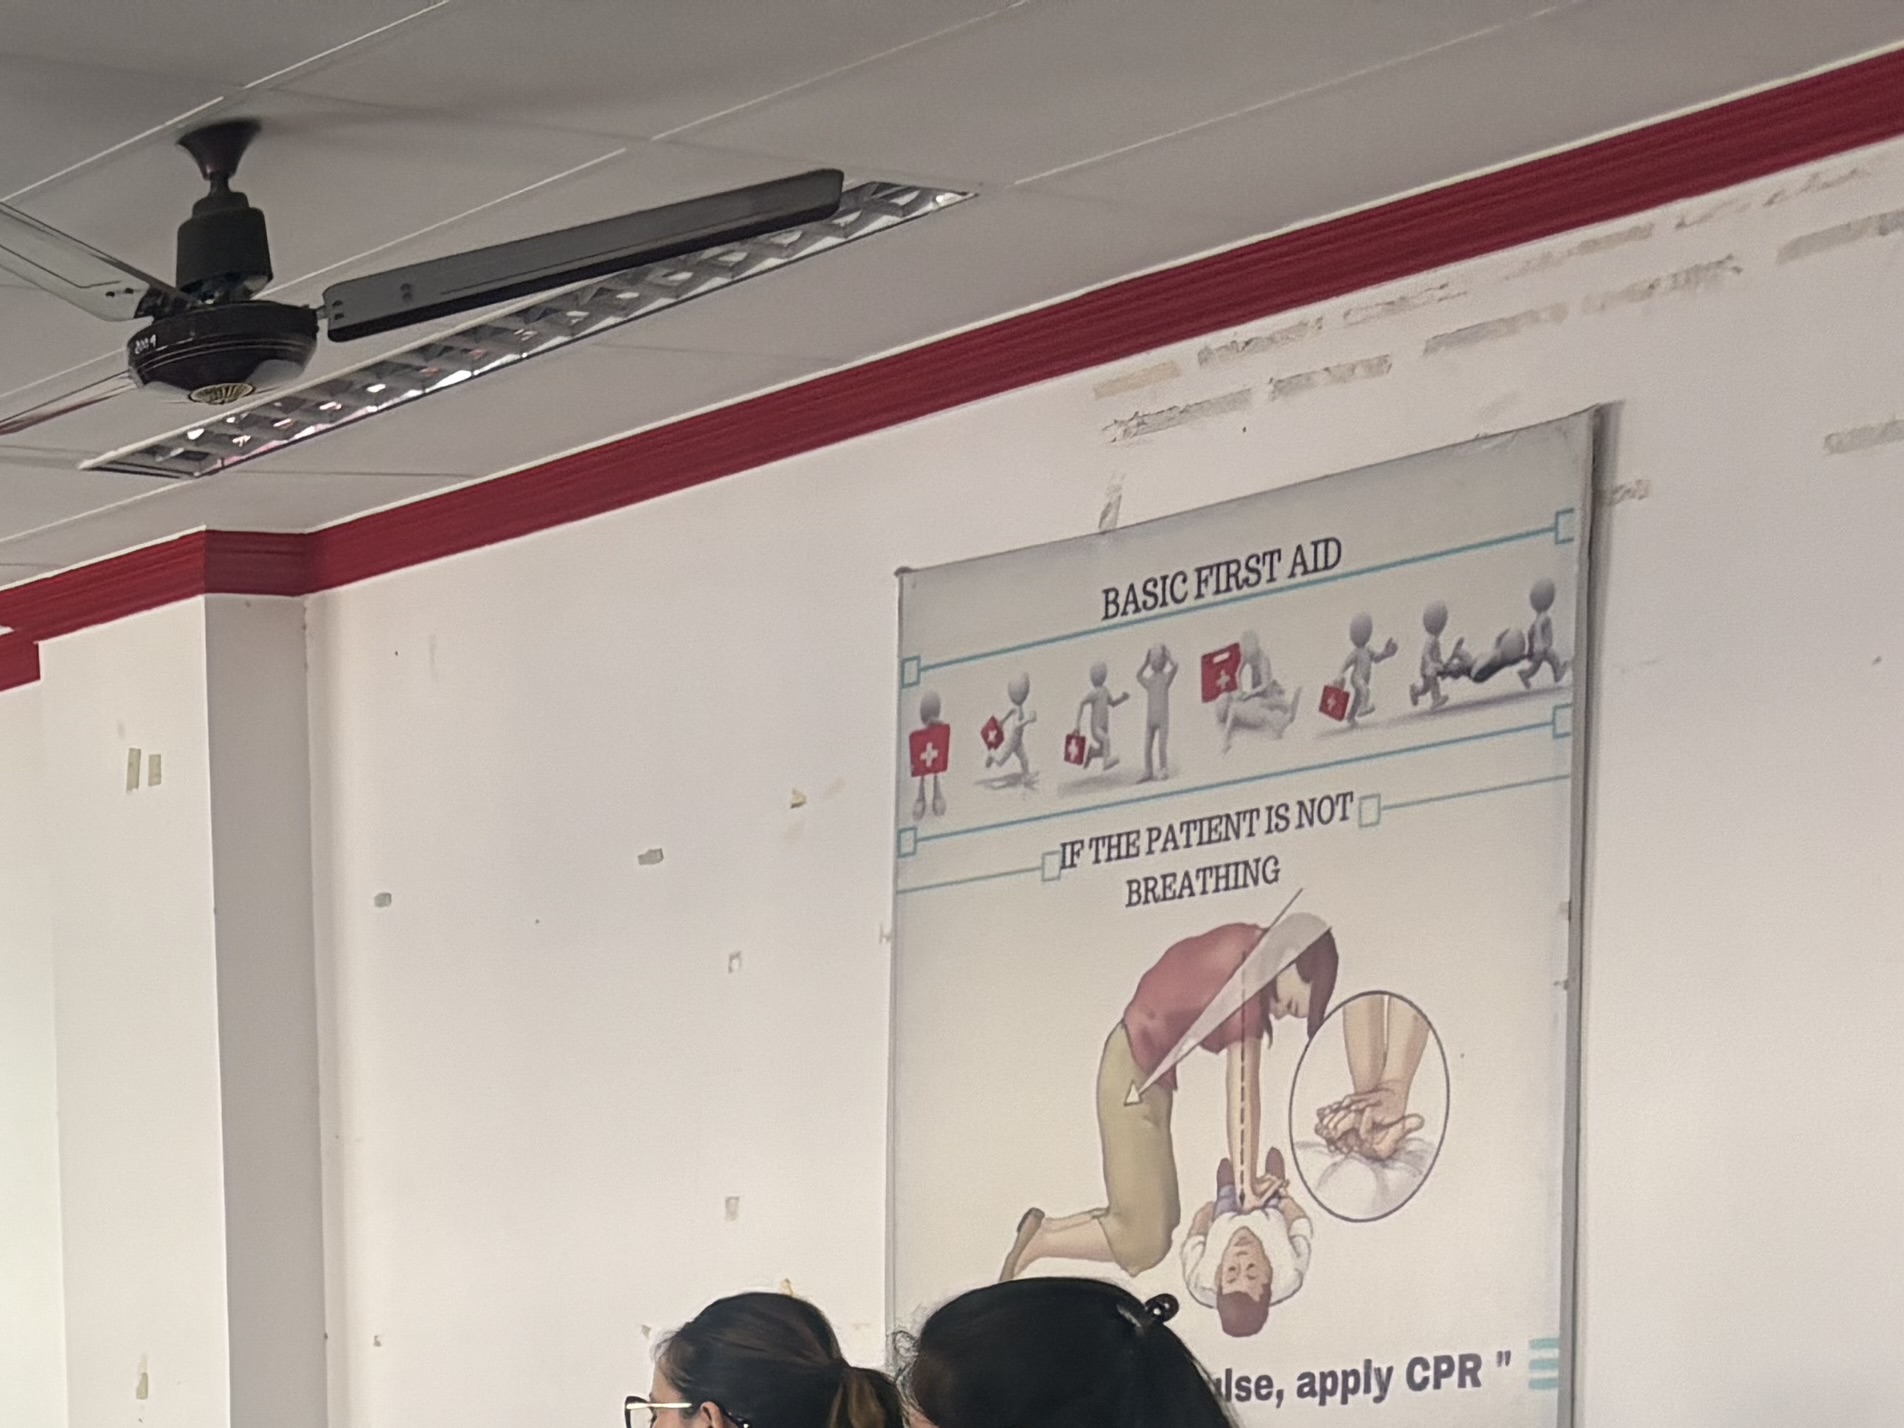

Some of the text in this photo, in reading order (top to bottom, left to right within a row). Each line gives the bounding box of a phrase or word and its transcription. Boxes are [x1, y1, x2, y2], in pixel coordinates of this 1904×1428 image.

[1101, 537, 1342, 621] BASIC FIRST AID
[1059, 791, 1354, 869] IF THE PATIENT IS NOT
[1125, 855, 1281, 908] BREATHING
[1296, 1358, 1394, 1406] apply
[1406, 1353, 1482, 1391] CPR
